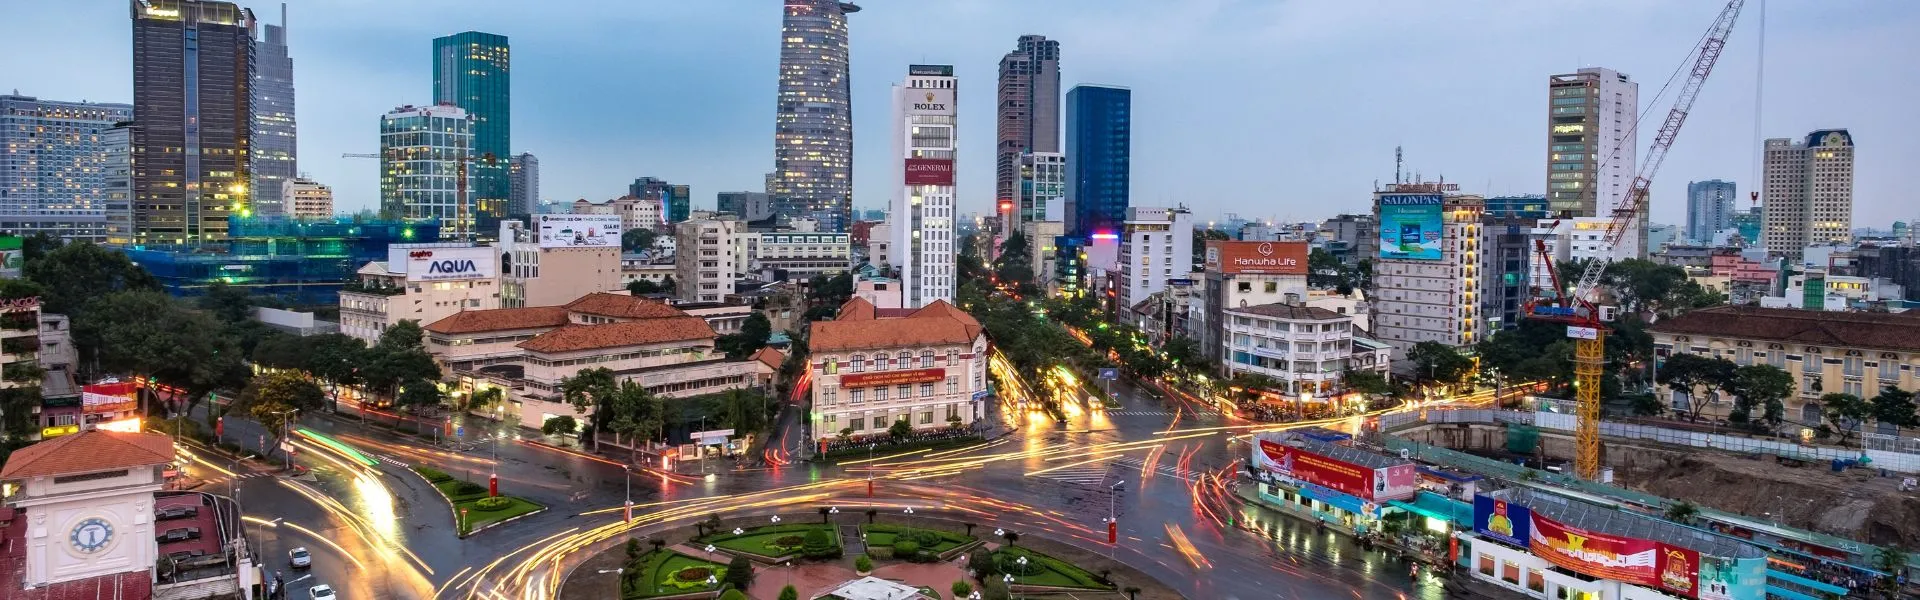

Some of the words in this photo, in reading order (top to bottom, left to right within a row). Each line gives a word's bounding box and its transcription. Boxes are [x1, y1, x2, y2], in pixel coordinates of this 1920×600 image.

[914, 103, 946, 111] ROLEX
[917, 164, 950, 172] GENERALI
[1383, 195, 1439, 205] SALONPAS
[409, 250, 433, 258] SANYO
[1234, 256, 1277, 266] Hanwha
[1278, 257, 1296, 266] Life
[429, 260, 476, 274] AQUA
